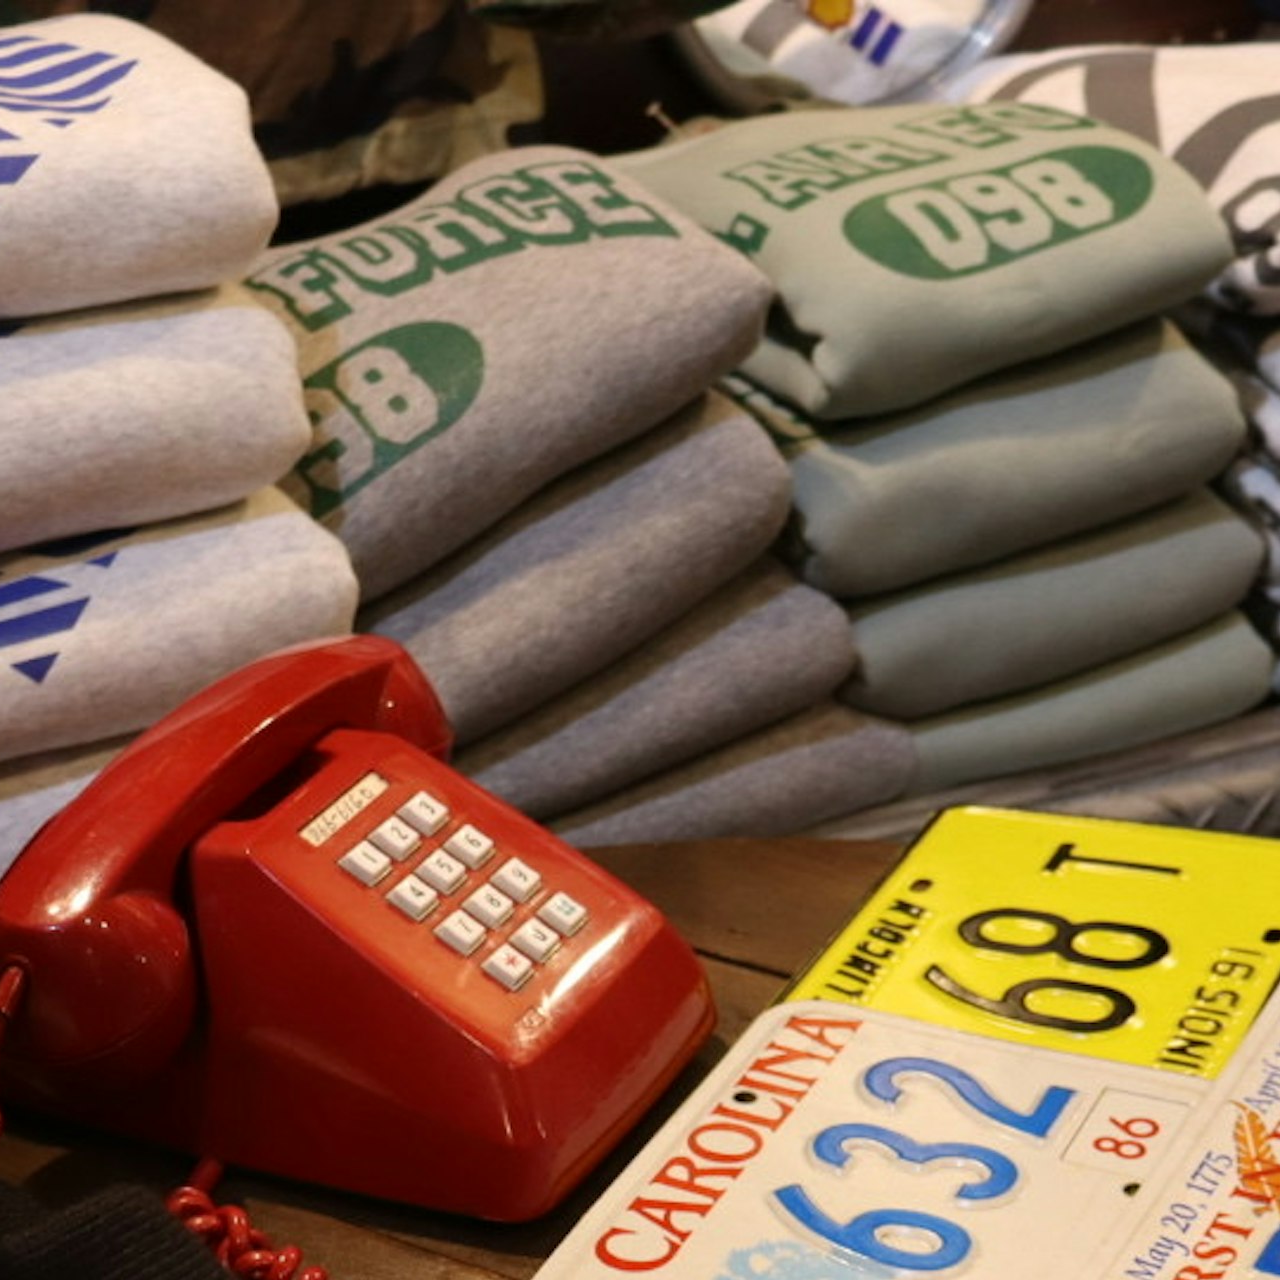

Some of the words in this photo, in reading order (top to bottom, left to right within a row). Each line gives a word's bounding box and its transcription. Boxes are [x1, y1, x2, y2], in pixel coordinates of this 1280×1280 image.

[243, 160, 682, 332] FORCE
[825, 899, 926, 997] LINCOLN
[593, 1014, 863, 1273] CAROLINA
[772, 1055, 1078, 1275] 632
[1094, 1115, 1161, 1161] 86
[1161, 1202, 1209, 1235] 20,
[1187, 1150, 1233, 1197] 1775
